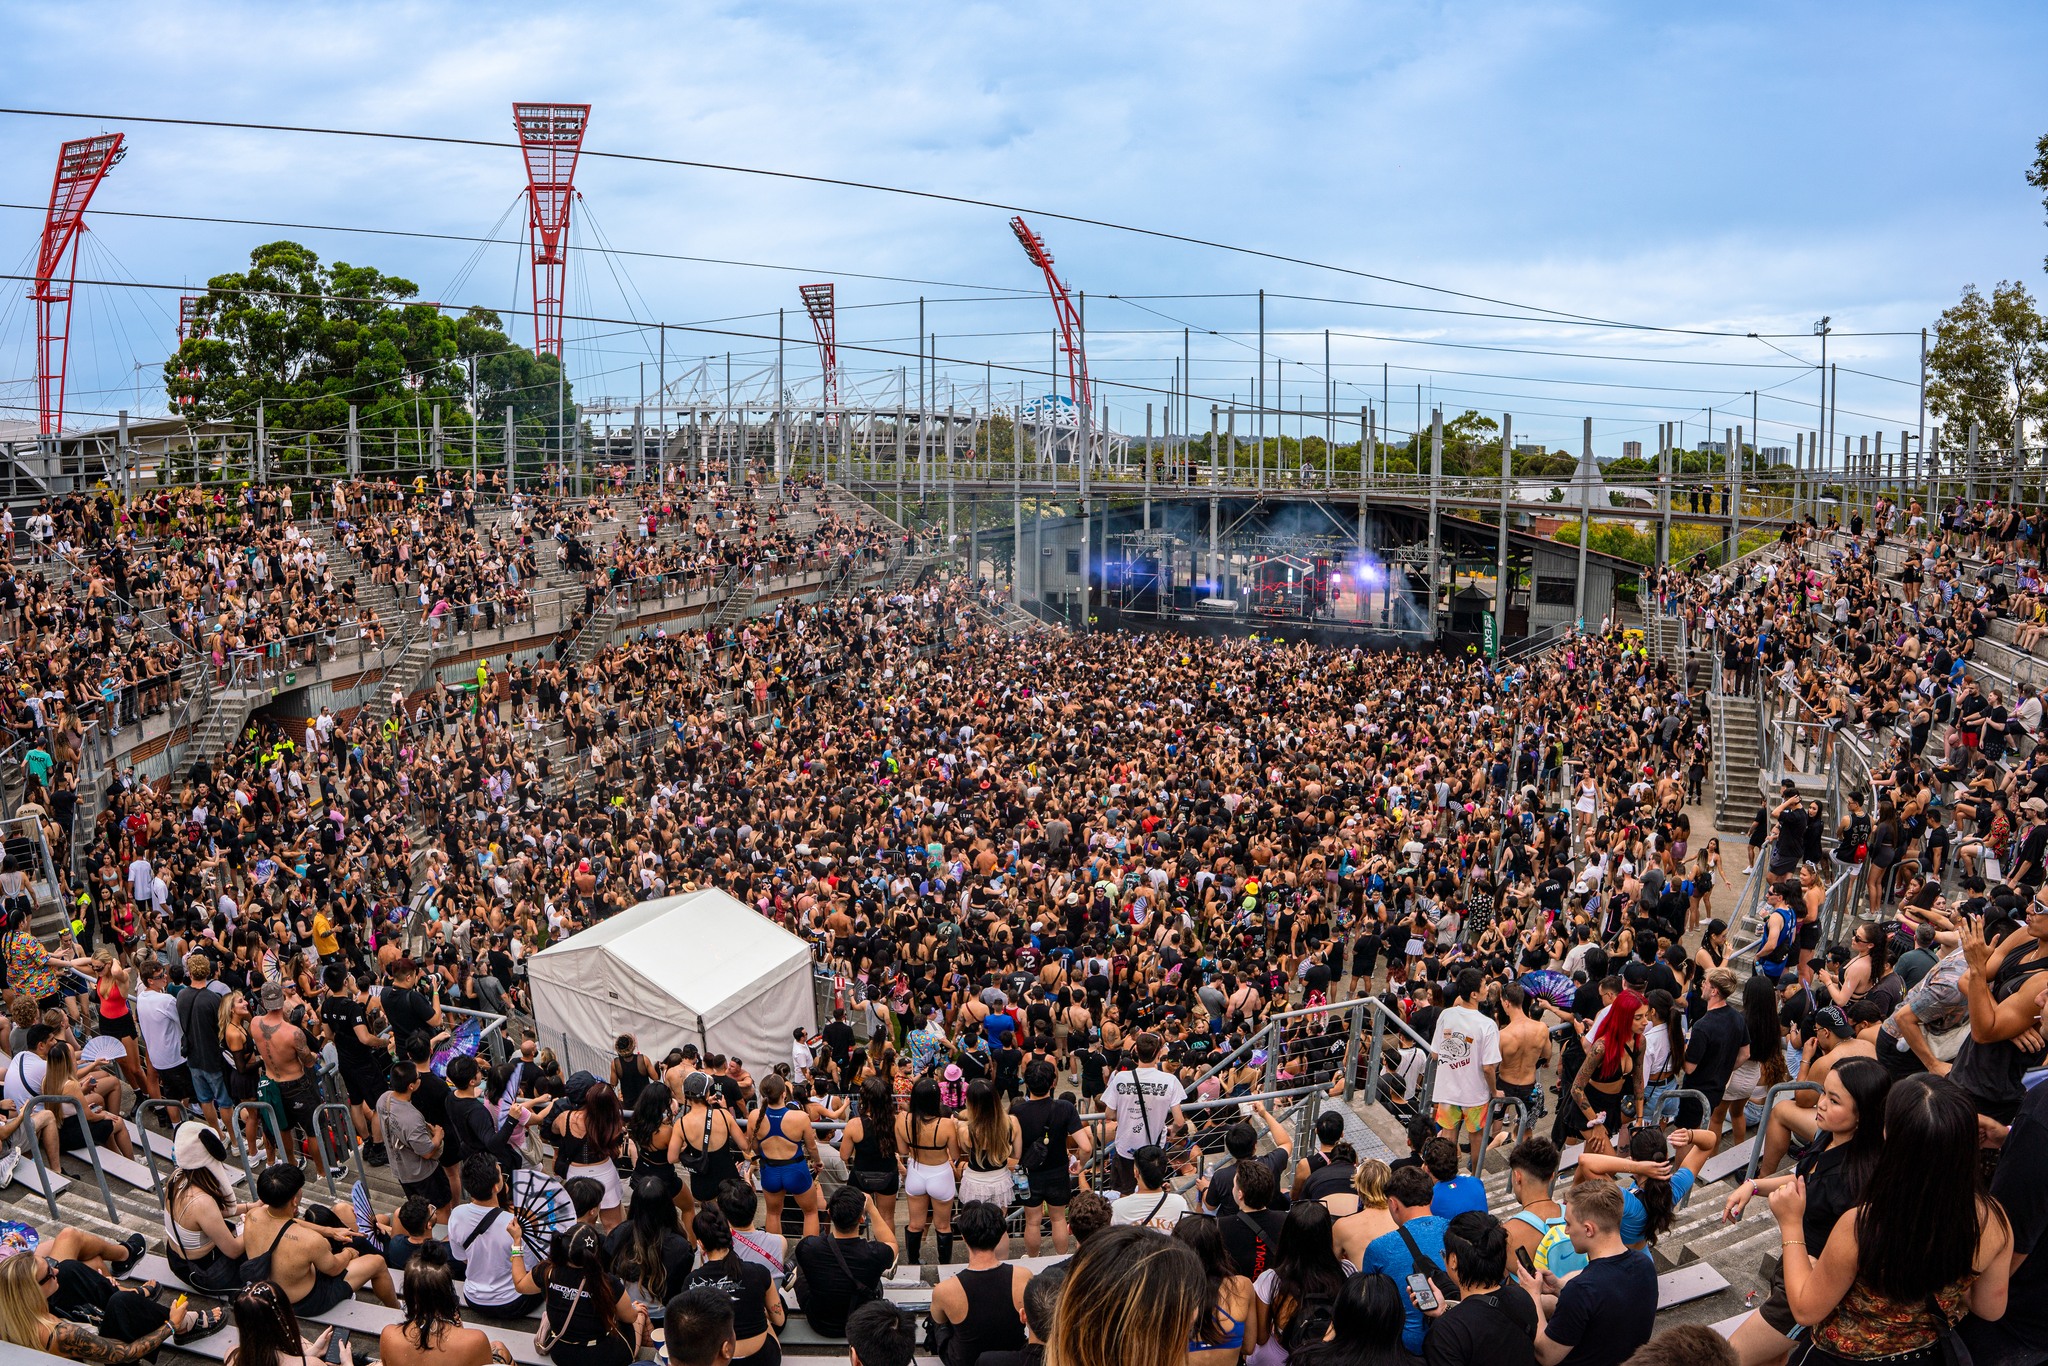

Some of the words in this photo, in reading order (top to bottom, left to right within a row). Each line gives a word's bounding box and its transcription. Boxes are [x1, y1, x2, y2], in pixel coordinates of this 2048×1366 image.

[1484, 628, 1493, 649] EXIT
[1015, 981, 1025, 994] 7
[1449, 1057, 1471, 1070] EVISU
[734, 1232, 767, 1256] SUPREME
[549, 1282, 592, 1299] NEOVISON
